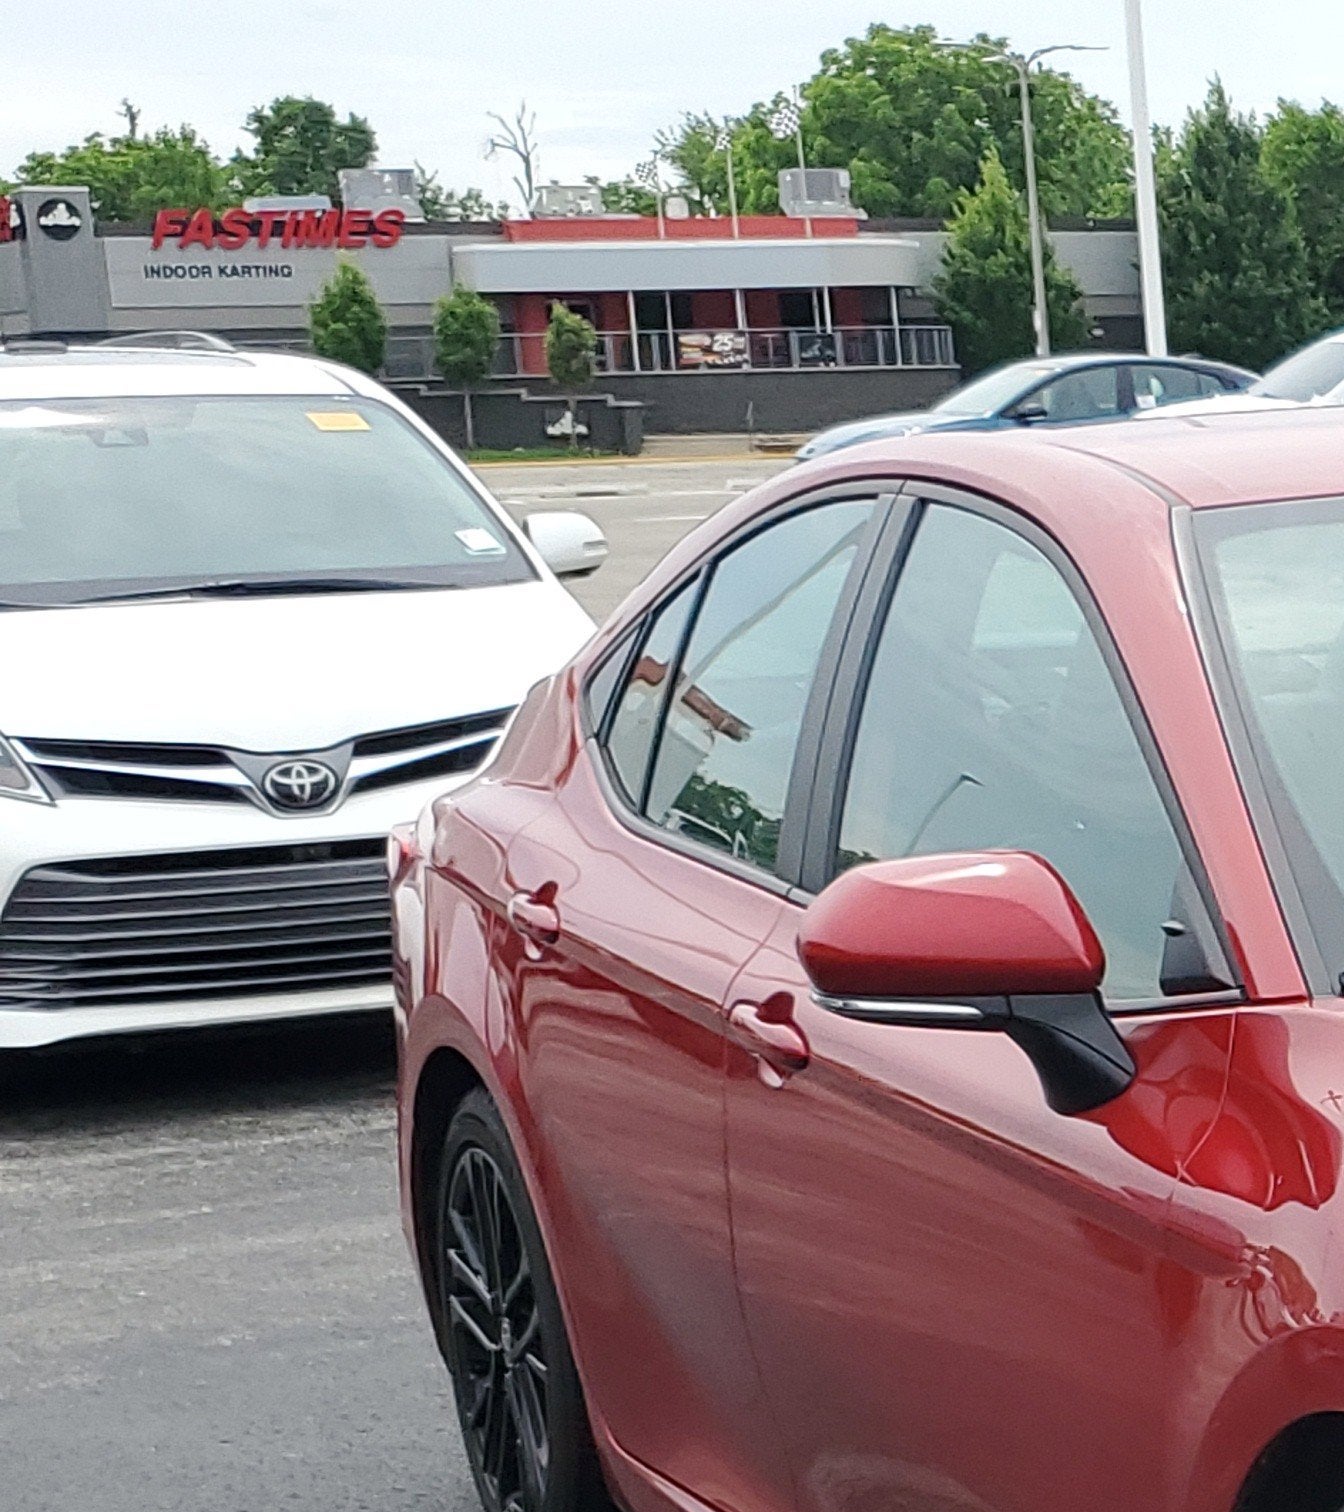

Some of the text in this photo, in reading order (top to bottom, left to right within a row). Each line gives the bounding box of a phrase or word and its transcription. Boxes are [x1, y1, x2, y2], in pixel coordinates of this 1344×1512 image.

[151, 208, 405, 249] FASTIMES
[144, 264, 293, 279] INDOOR KARTING
